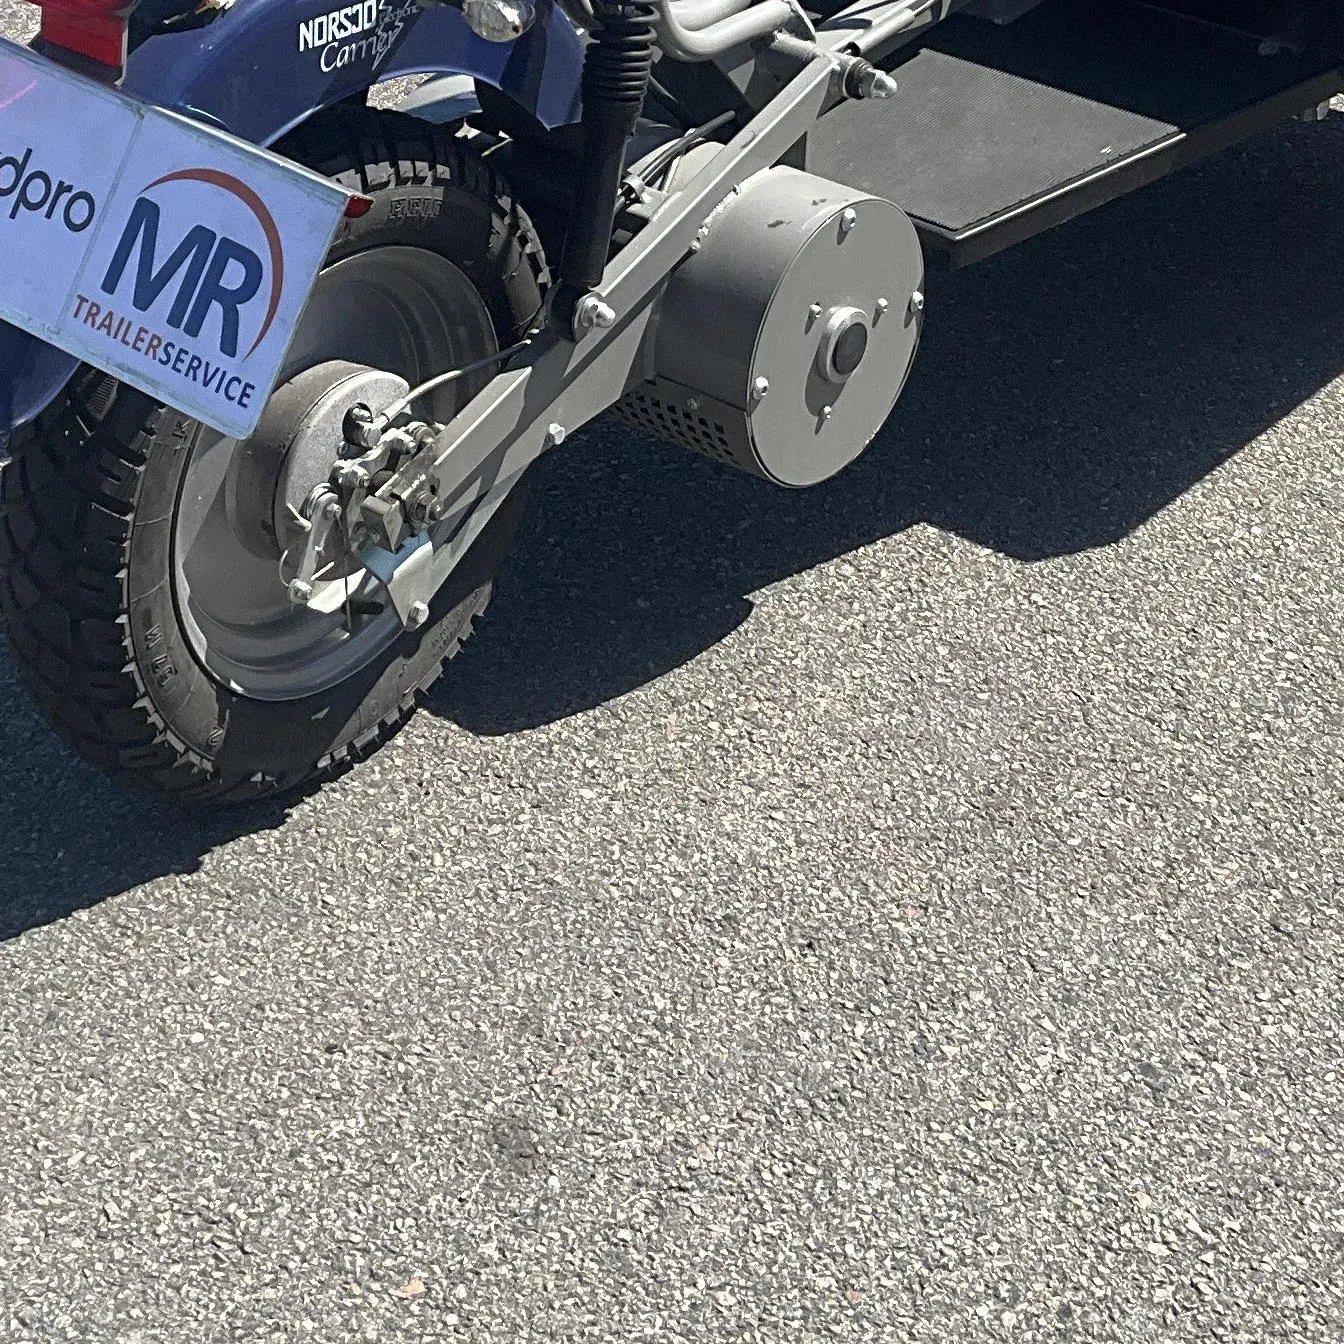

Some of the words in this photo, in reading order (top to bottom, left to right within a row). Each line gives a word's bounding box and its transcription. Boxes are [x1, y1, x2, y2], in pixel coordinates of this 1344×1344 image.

[320, 30, 398, 72] Carrier
[100, 196, 264, 358] MR
[72, 294, 256, 409] TRAILERSERVICE
